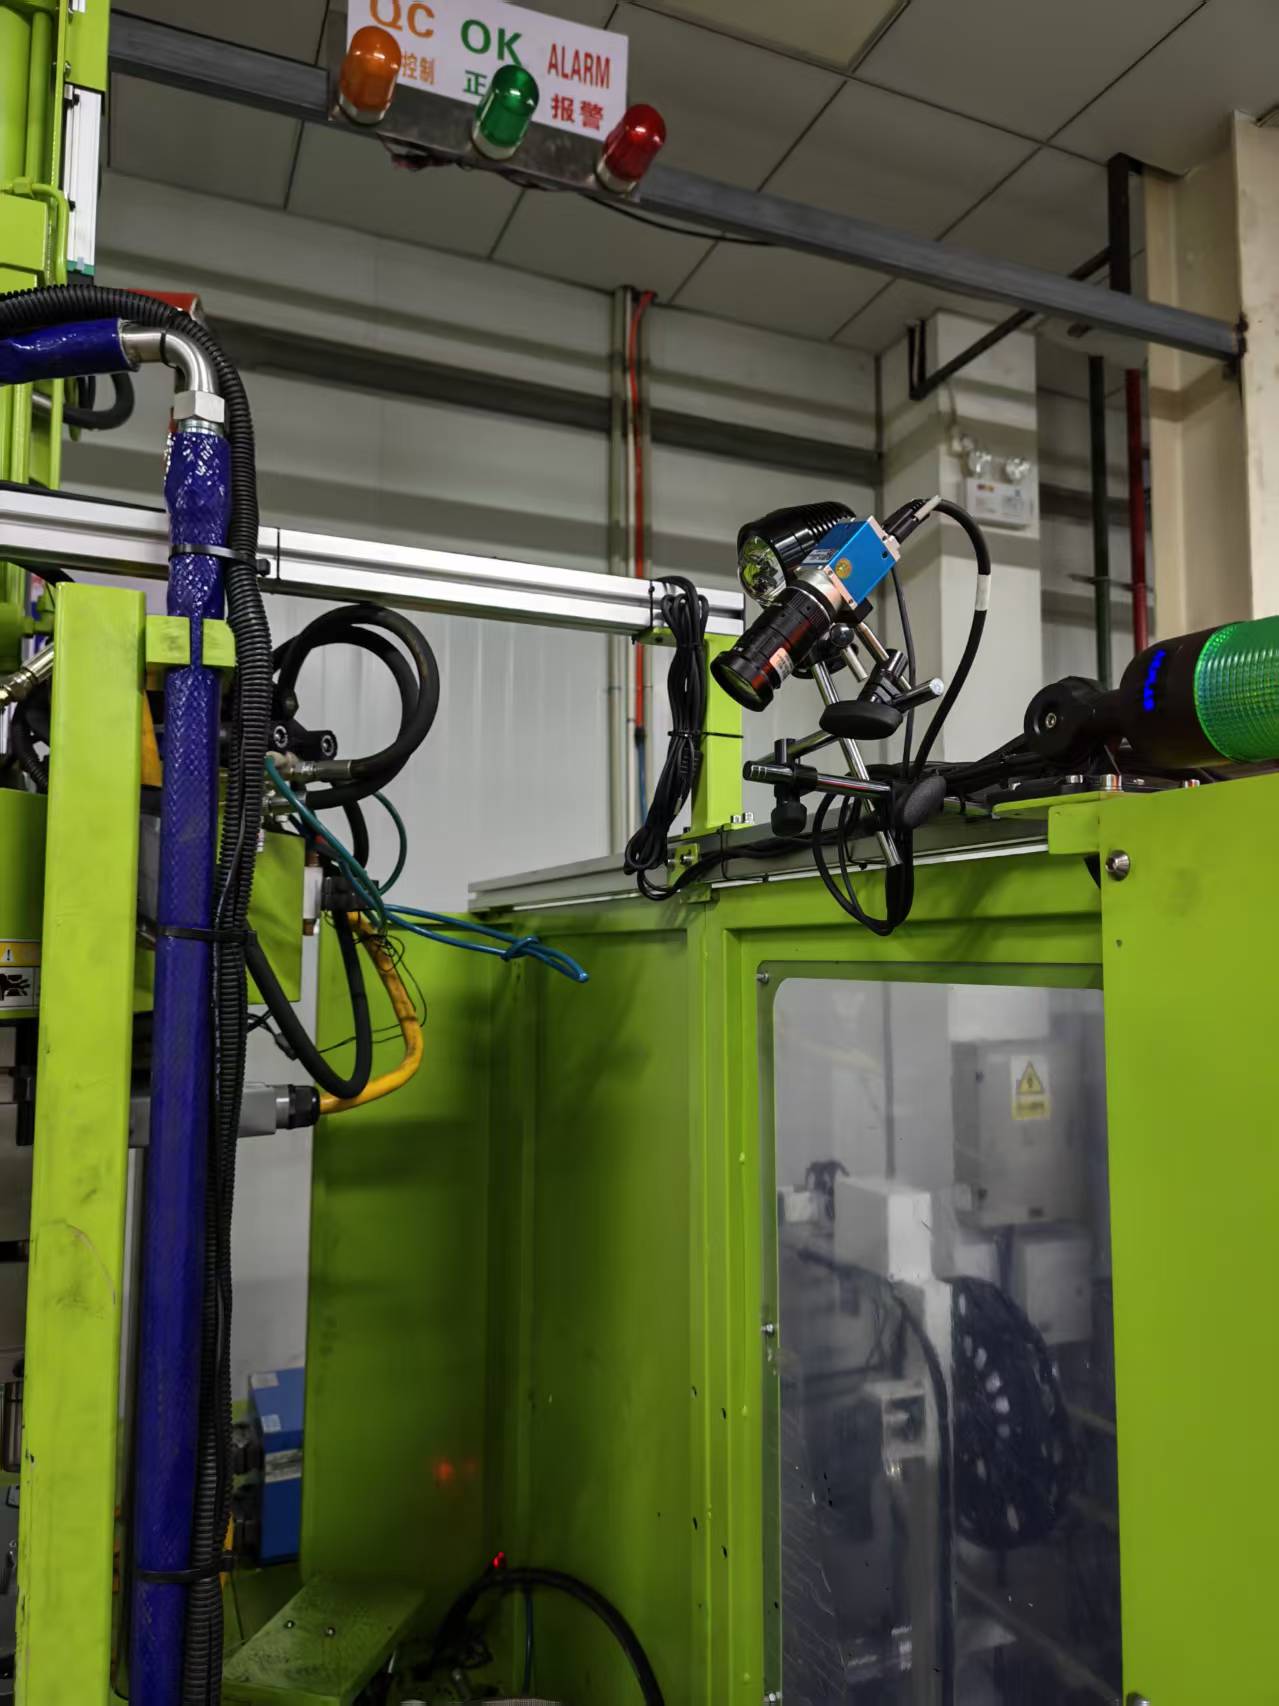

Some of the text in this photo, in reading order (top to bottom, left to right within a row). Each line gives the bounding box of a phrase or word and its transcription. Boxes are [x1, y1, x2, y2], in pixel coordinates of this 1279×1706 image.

[370, 0, 434, 38] QC
[460, 19, 522, 67] OK
[547, 42, 611, 90] ALARM
[551, 93, 604, 131] 报警
